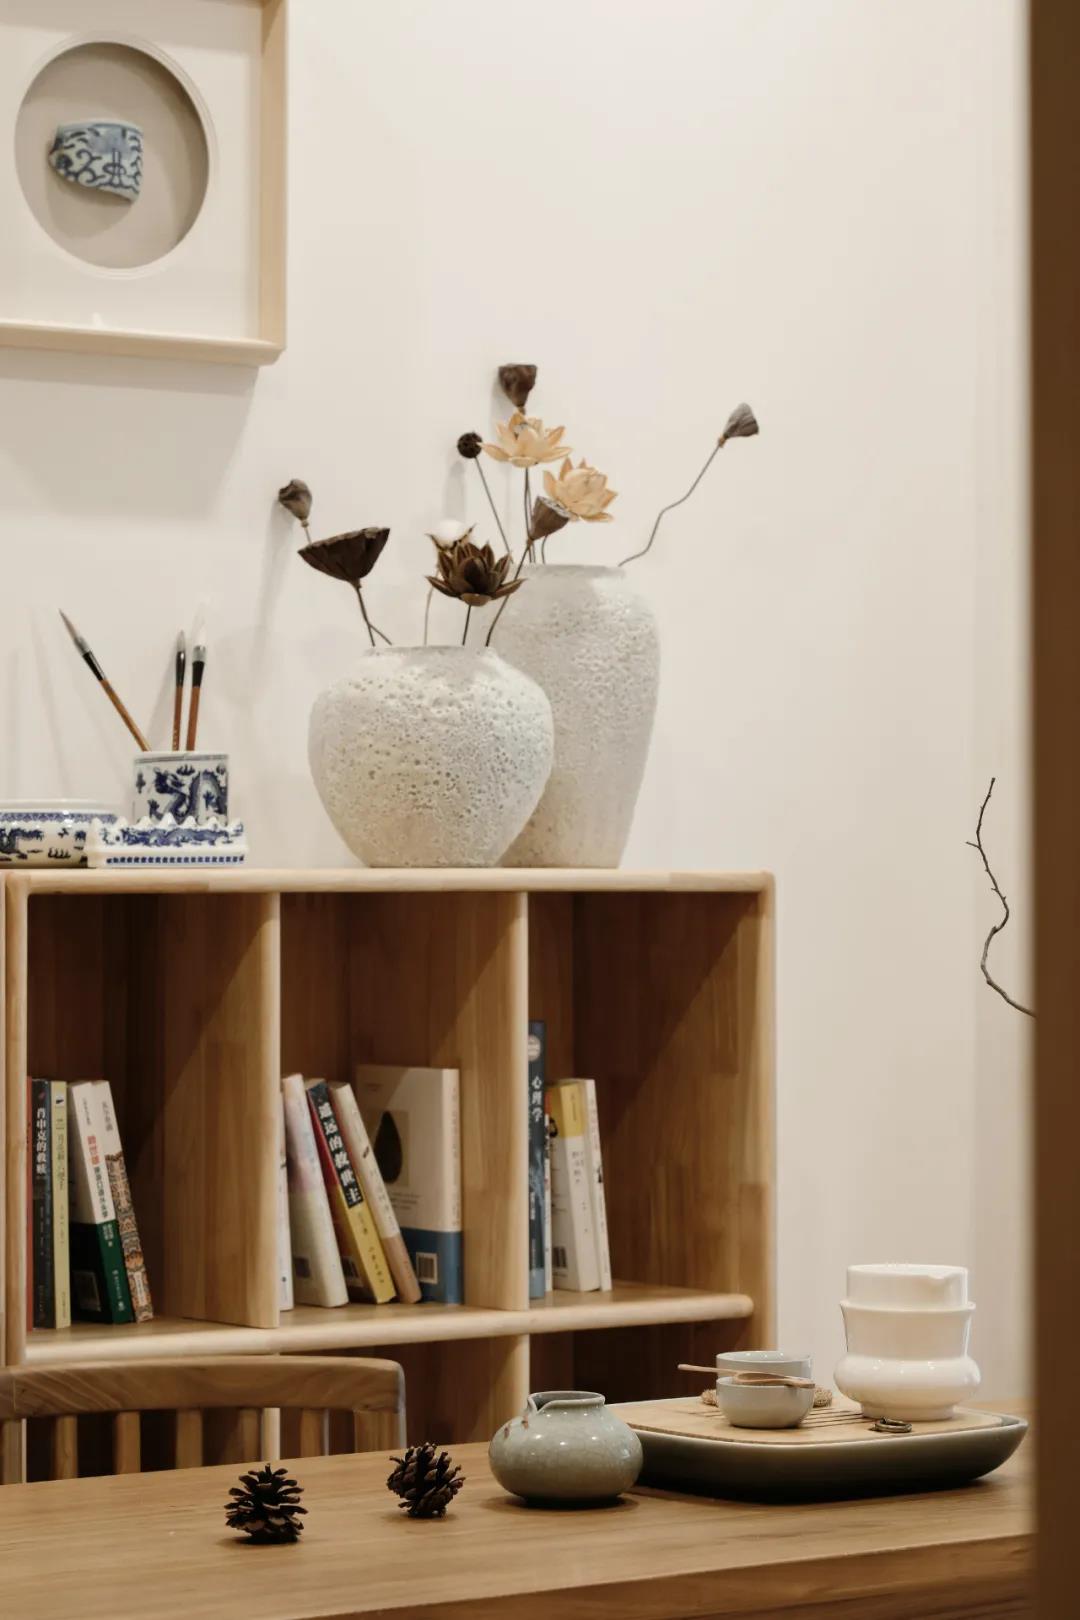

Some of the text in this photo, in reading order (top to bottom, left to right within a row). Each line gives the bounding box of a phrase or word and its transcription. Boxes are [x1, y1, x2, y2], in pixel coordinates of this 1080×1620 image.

[531, 1076, 543, 1122] 心理学
[318, 1102, 361, 1203] 遥远的救世主
